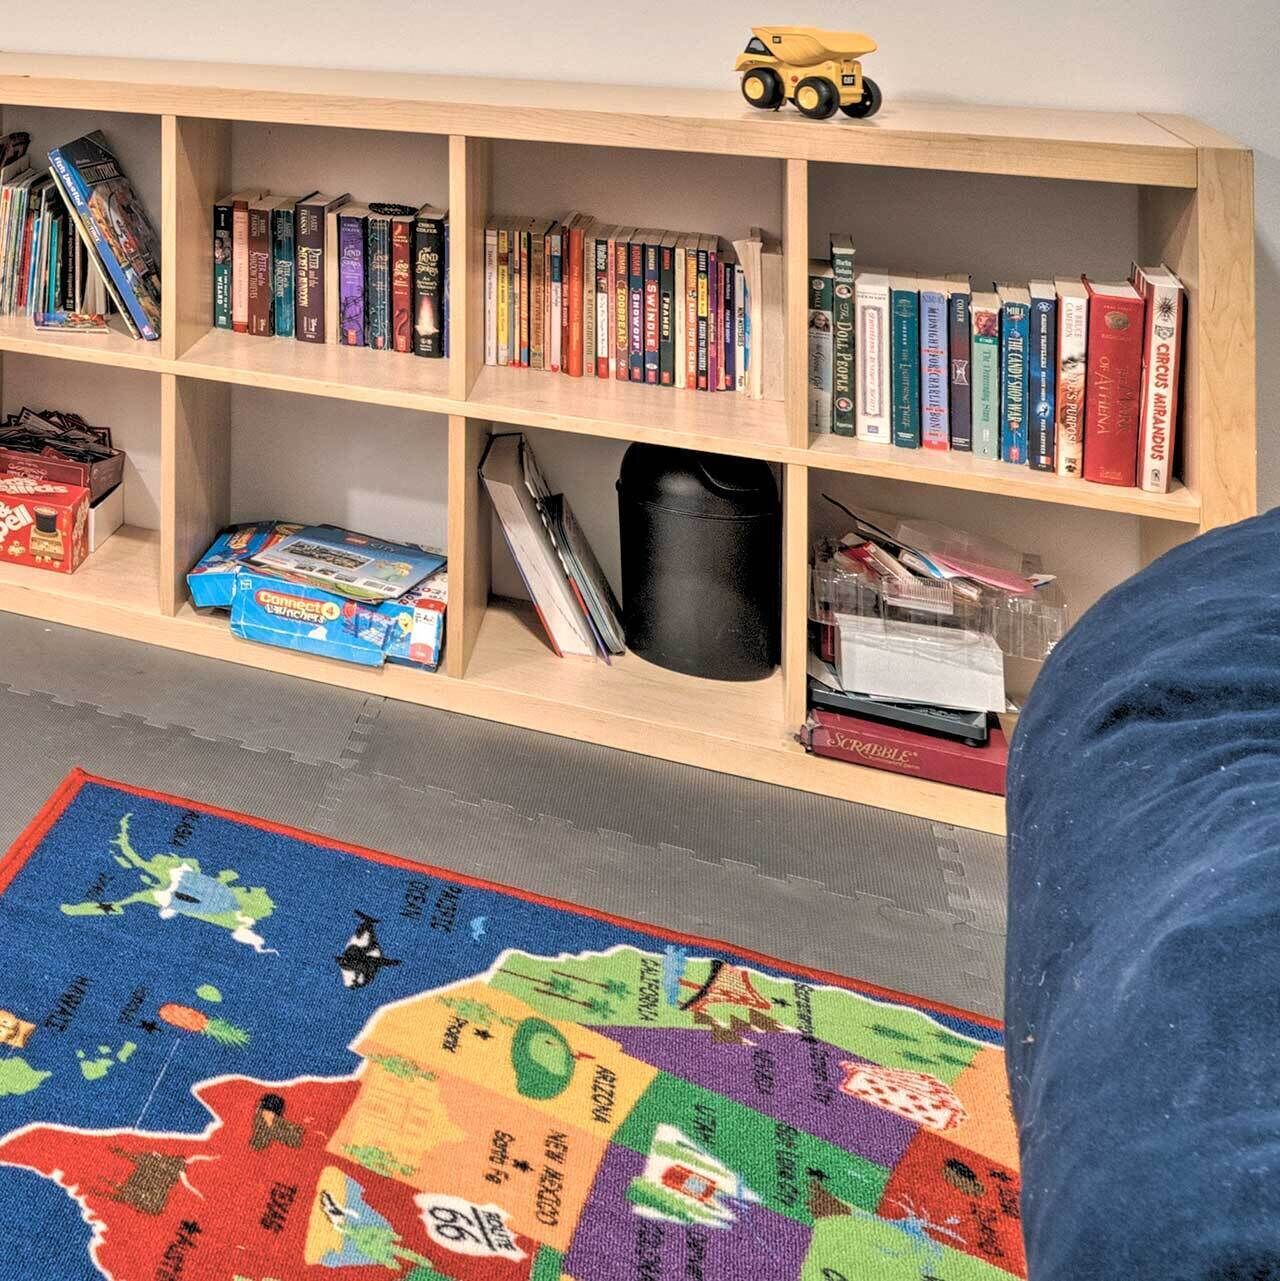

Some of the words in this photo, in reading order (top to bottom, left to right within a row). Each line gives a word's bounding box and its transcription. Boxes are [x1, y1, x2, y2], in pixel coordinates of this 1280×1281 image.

[259, 253, 268, 272] PETER
[298, 246, 310, 269] SECRET
[308, 248, 322, 269] PETER
[418, 250, 438, 261] LAND
[596, 244, 607, 270] Wallace
[618, 246, 626, 274] KORMAN
[632, 246, 640, 276] KORMAN
[618, 288, 626, 343] ZOOBREAK
[646, 284, 657, 347] SWINDLE
[662, 297, 670, 336] FRAMED
[814, 290, 822, 309] HALL
[840, 302, 849, 320] The
[956, 299, 964, 322] COLFER
[632, 294, 640, 349] SHOWOFF
[836, 321, 852, 350] DOLL
[927, 307, 940, 349] MIDNIGHT
[1066, 303, 1074, 338] CAMERON
[927, 354, 939, 368] FOR
[1008, 337, 1023, 352] THE
[836, 352, 852, 392] PEOPLE
[1008, 354, 1022, 379] CANDY
[1101, 356, 1110, 371] OF
[1154, 344, 1170, 389] CIRCUS
[900, 364, 912, 403] LIGHTNING
[927, 372, 940, 408] CHARLIE
[1008, 382, 1022, 402] SHOP
[1008, 404, 1022, 422] WAR
[1094, 372, 1113, 434] ATHENA
[1064, 402, 1077, 445] PURPOSE
[1150, 394, 1167, 461] MIRANDUS
[259, 591, 322, 612] Connect
[266, 604, 324, 624] Launchers
[828, 733, 910, 764] SCRABBLE
[168, 811, 199, 847] ALASKA
[400, 880, 430, 918] OCEAN
[44, 975, 91, 1032] HAWAII
[638, 959, 659, 1020] CALIFORNIA
[442, 1015, 468, 1054] Phoenix
[753, 1048, 778, 1096] NEVADA
[591, 1064, 616, 1124] ARIZONA
[694, 1104, 716, 1144] UTAH
[488, 1128, 516, 1164] Santa
[544, 1130, 568, 1162] NEW
[483, 1168, 512, 1184] Fe
[260, 1182, 299, 1232] TEXAS
[536, 1164, 562, 1226] MEXICO
[430, 1206, 480, 1241] 66
[486, 1212, 516, 1250] ROUTE
